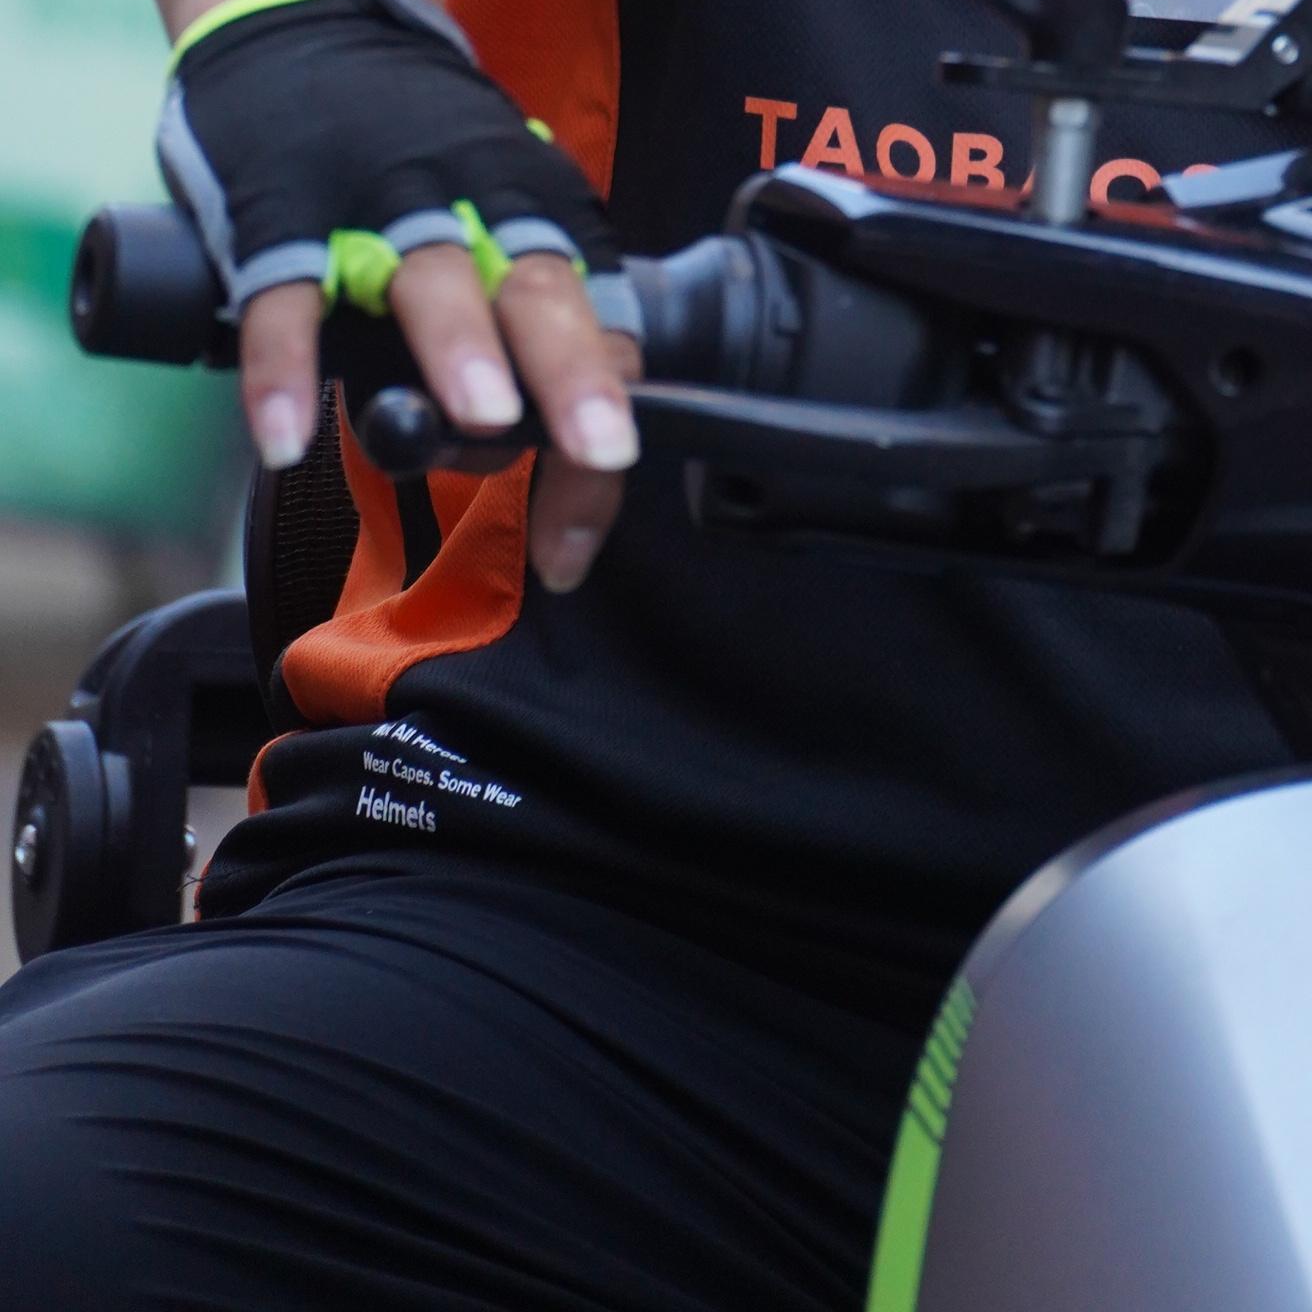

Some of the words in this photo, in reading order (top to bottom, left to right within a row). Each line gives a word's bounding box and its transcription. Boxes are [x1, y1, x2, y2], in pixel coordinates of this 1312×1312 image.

[391, 723, 418, 744] All
[363, 750, 390, 774] Wear
[392, 758, 435, 786] Capes.
[437, 769, 483, 798] Some
[482, 782, 523, 808] Wear
[355, 785, 437, 833] Helmets
